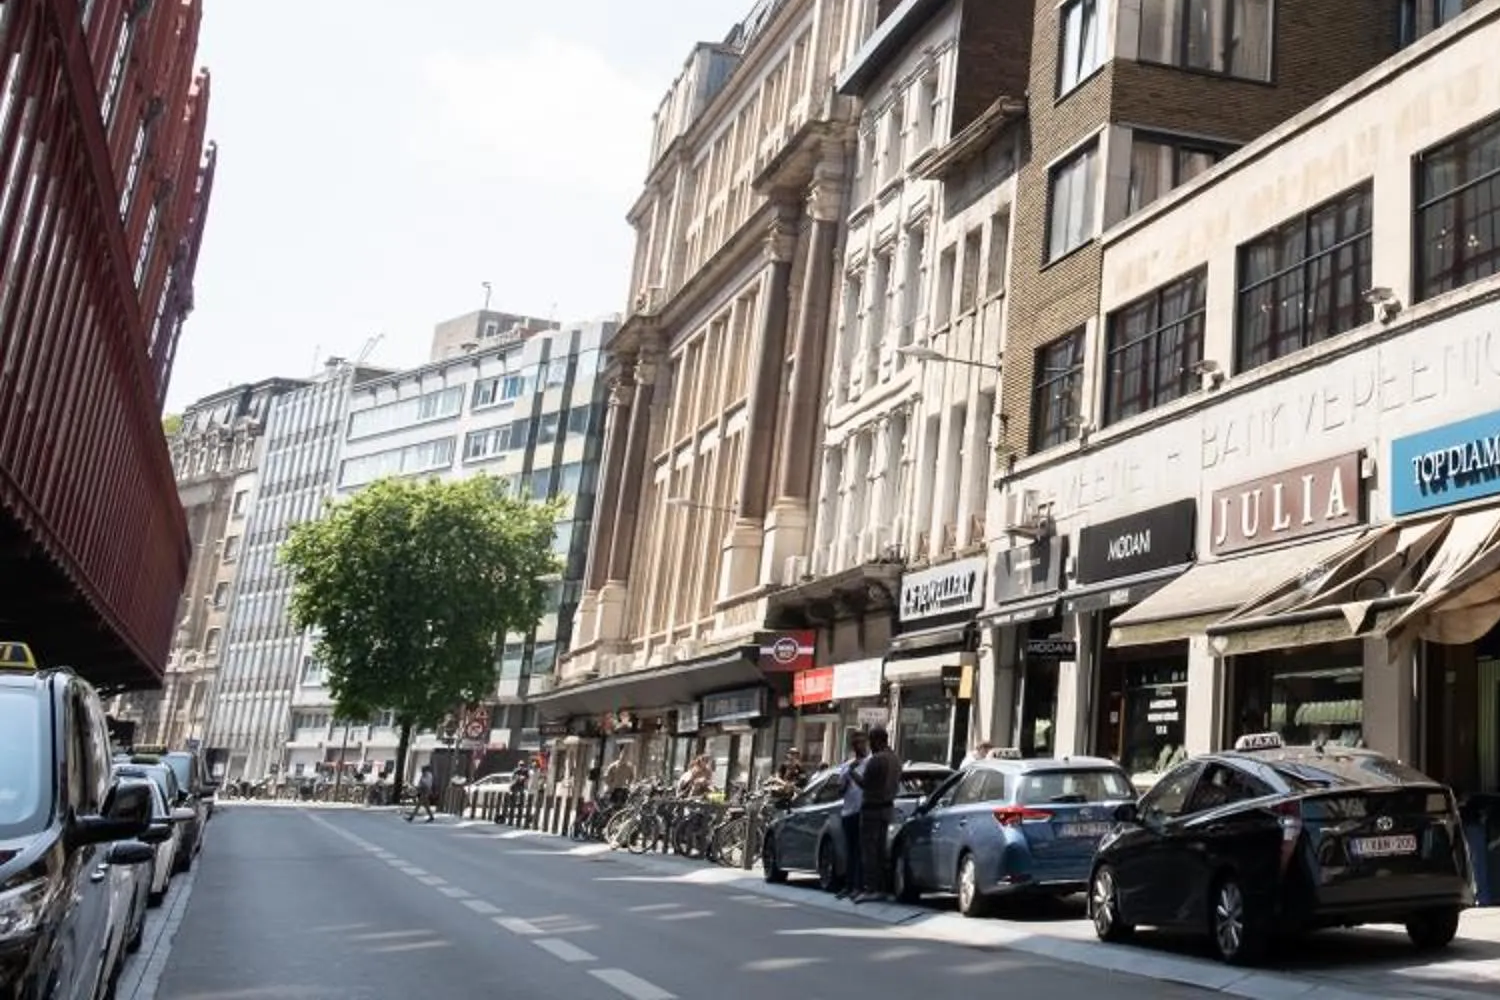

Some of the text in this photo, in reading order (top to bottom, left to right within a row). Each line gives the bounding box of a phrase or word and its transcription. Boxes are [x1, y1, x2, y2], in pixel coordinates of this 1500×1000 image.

[1411, 452, 1443, 485] TOP
[1215, 466, 1349, 545] JULIA
[1107, 529, 1151, 561] MODANI
